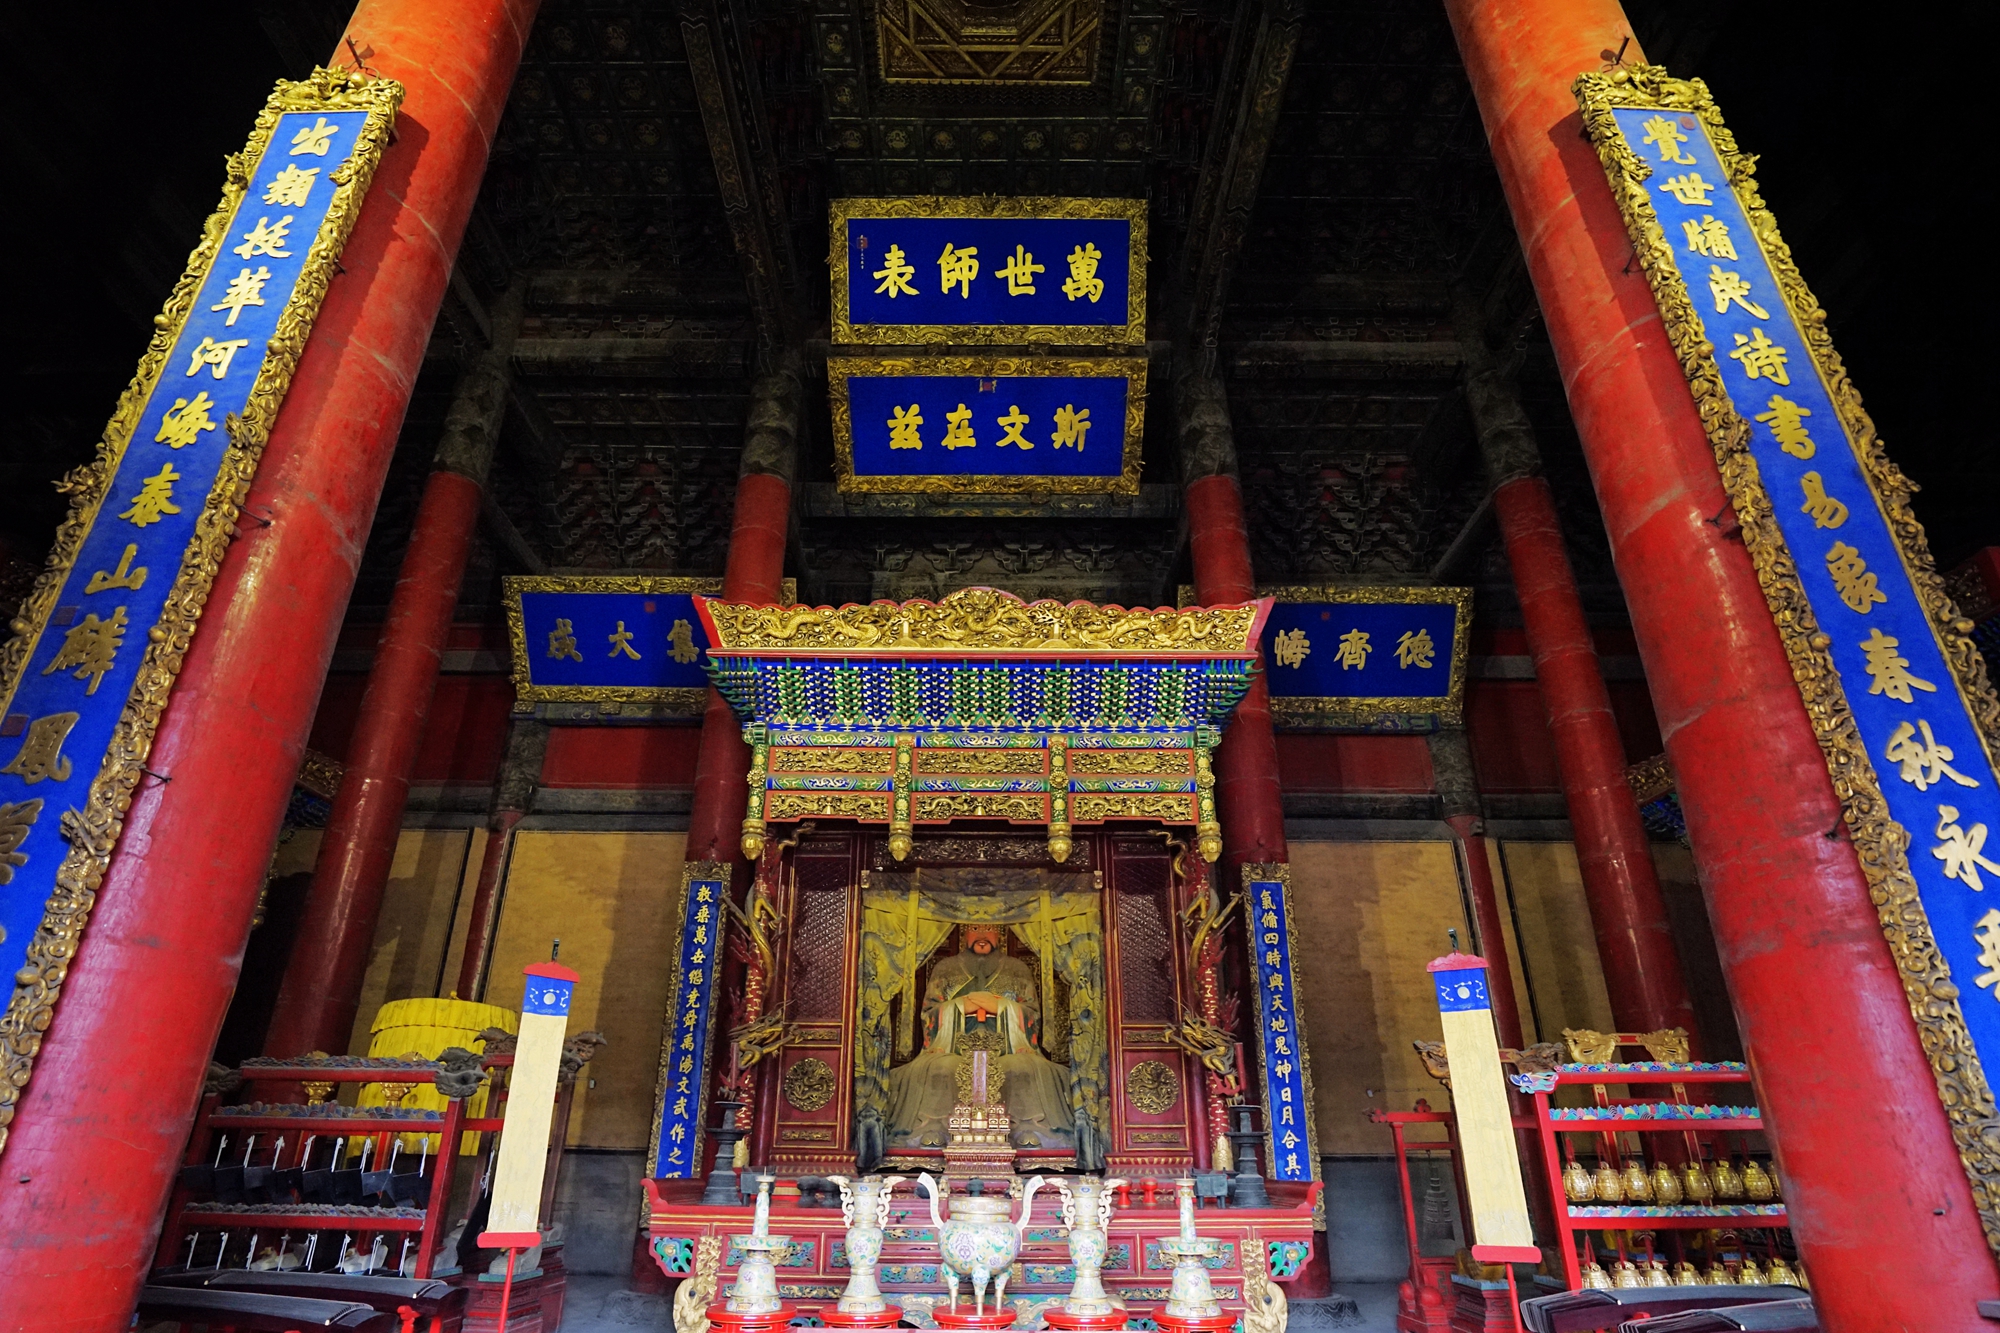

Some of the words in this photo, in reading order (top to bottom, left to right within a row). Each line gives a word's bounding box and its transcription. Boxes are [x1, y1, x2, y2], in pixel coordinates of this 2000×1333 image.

[873, 241, 1105, 303] 萬世師表
[665, 884, 714, 1179] 教垂萬世繼堯舜禹湯文武作之
